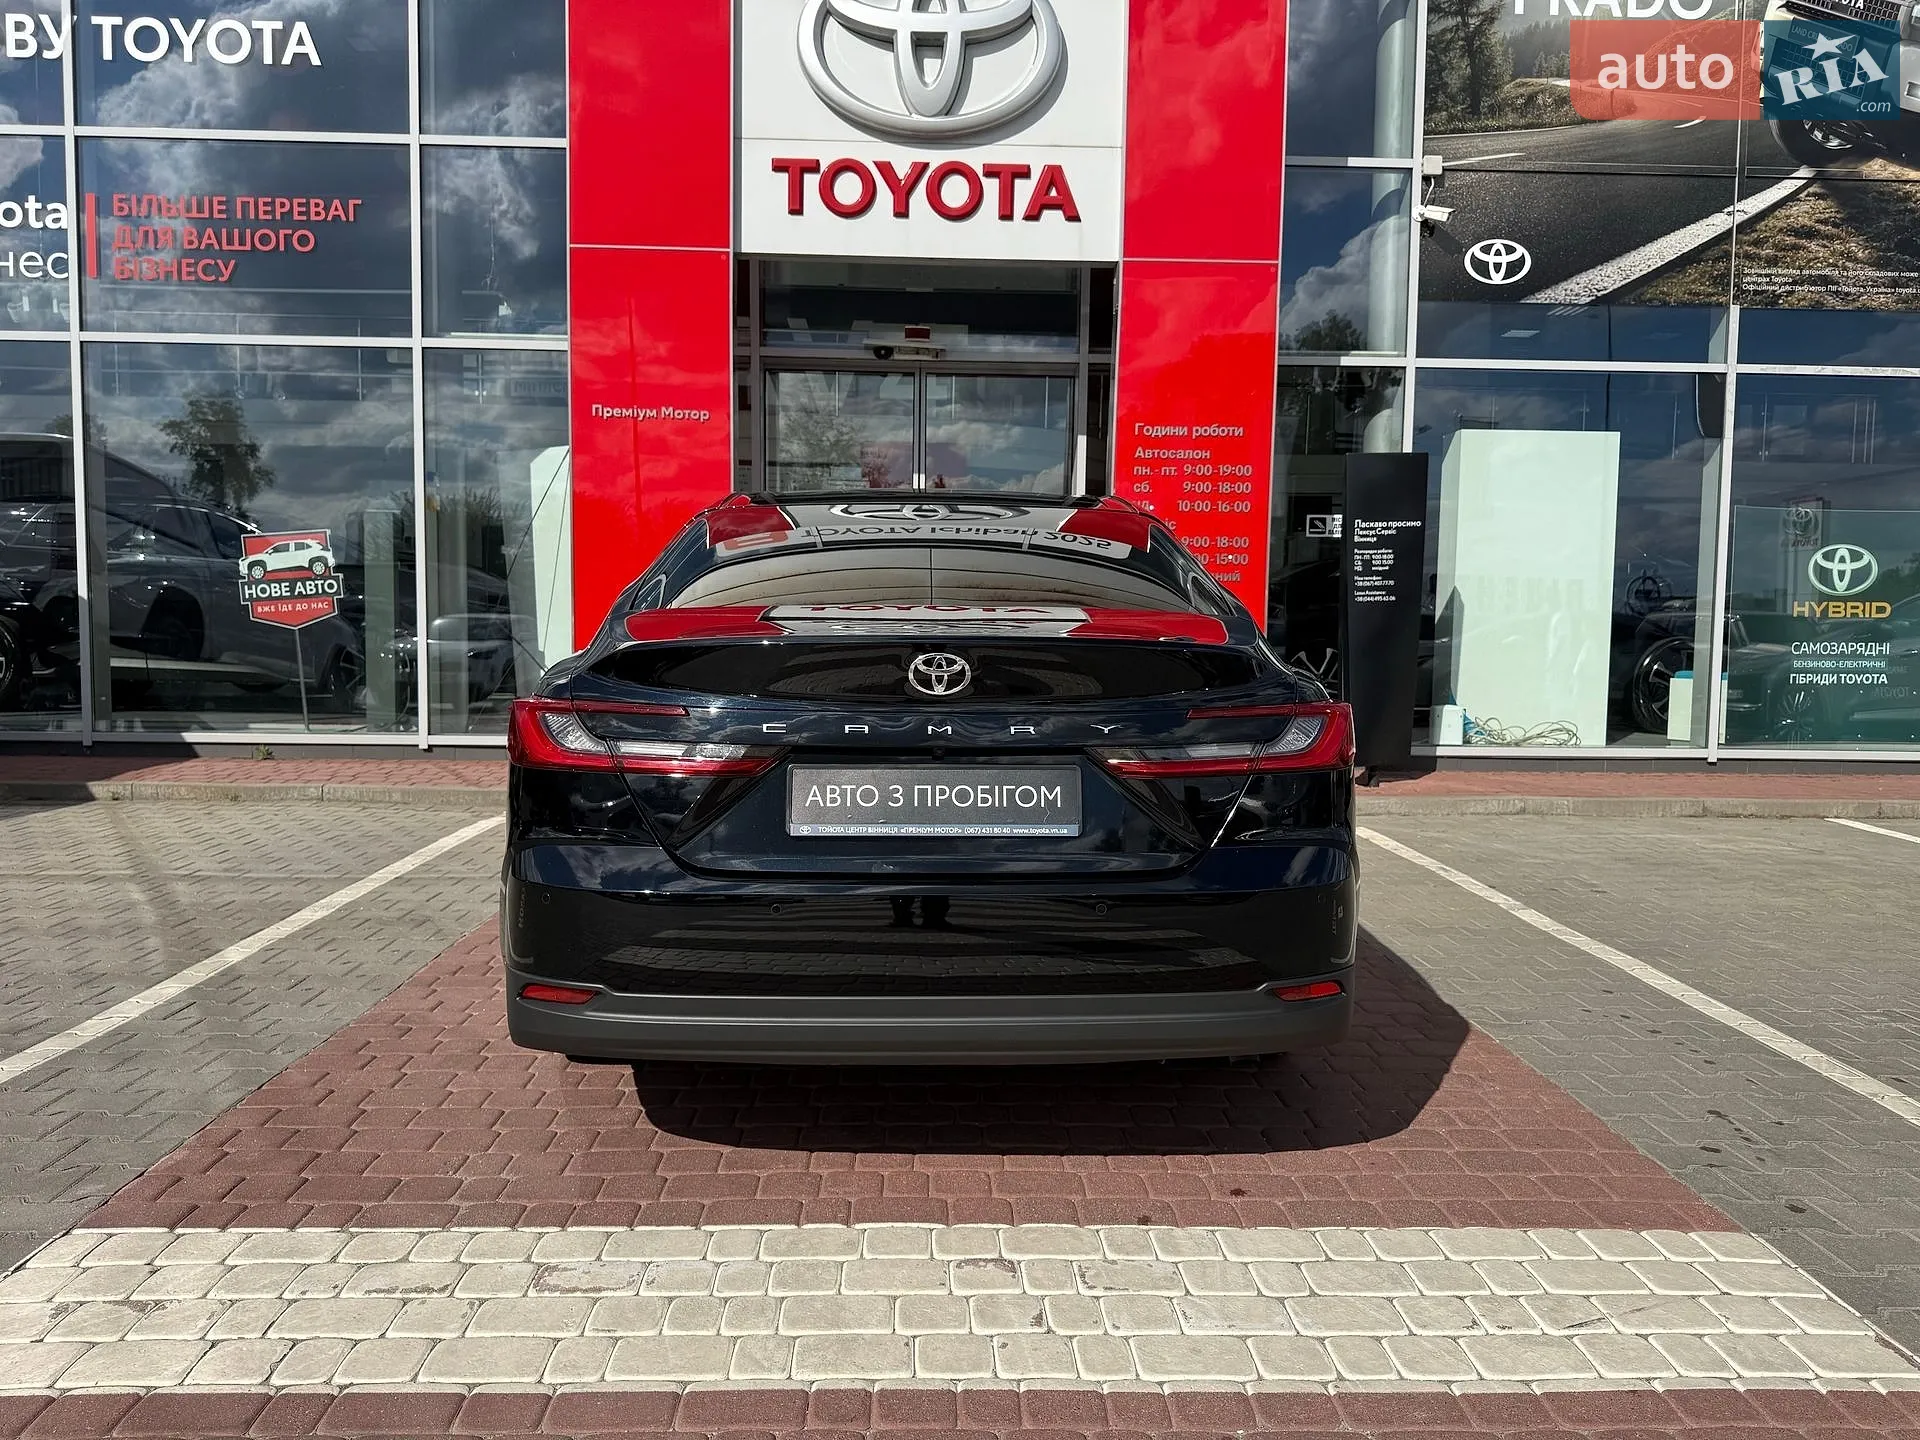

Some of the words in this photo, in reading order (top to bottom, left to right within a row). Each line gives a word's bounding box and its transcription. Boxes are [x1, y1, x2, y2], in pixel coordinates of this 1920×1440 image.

[91, 15, 321, 66] TOYOTA
[771, 157, 1082, 222] TOYOTA
[112, 193, 227, 219] БІЛЬШЕ
[236, 196, 362, 222] ПЕРЕВАГ
[112, 226, 174, 251] ДЛЯ
[182, 228, 316, 253] ВАШОГО
[114, 257, 236, 282] БІЗНЕСУ
[592, 403, 657, 422] Преміум
[661, 406, 710, 422] Мотор
[1134, 422, 1188, 437] Години
[1192, 424, 1244, 439] роботи
[1134, 447, 1210, 459] Автосалон
[1183, 464, 1252, 476] 9:00-19:00
[1133, 482, 1152, 493] сб.
[1183, 481, 1252, 493] 9:00-18:00
[1177, 500, 1251, 512] 10:00-16:00
[1354, 519, 1387, 528] Ласкаво
[1388, 520, 1421, 529] просимо
[1182, 535, 1249, 548] 9:00-18:00
[244, 583, 290, 599] НОВЕ
[294, 580, 338, 596] АВТО
[257, 605, 275, 613] ВЖЕ
[296, 603, 308, 611] ДО
[1792, 601, 1893, 618] HYBRID
[1791, 641, 1890, 656] САМОЗАРЯДНІ
[1793, 660, 1886, 669] БЕНЗИНОВО-ЕЛЕКТРИЧНІ
[1789, 673, 1837, 685] ГІБРИДИ
[1839, 674, 1888, 685] TOYOTA
[762, 723, 1123, 735] CAMRY
[805, 785, 880, 807] АВТО
[913, 785, 1062, 808] ПРОБІГОМ
[845, 826, 867, 834] ЦЕНТР
[964, 827, 981, 835] (067)
[1012, 827, 1068, 835] www.toyota.vn.ua
